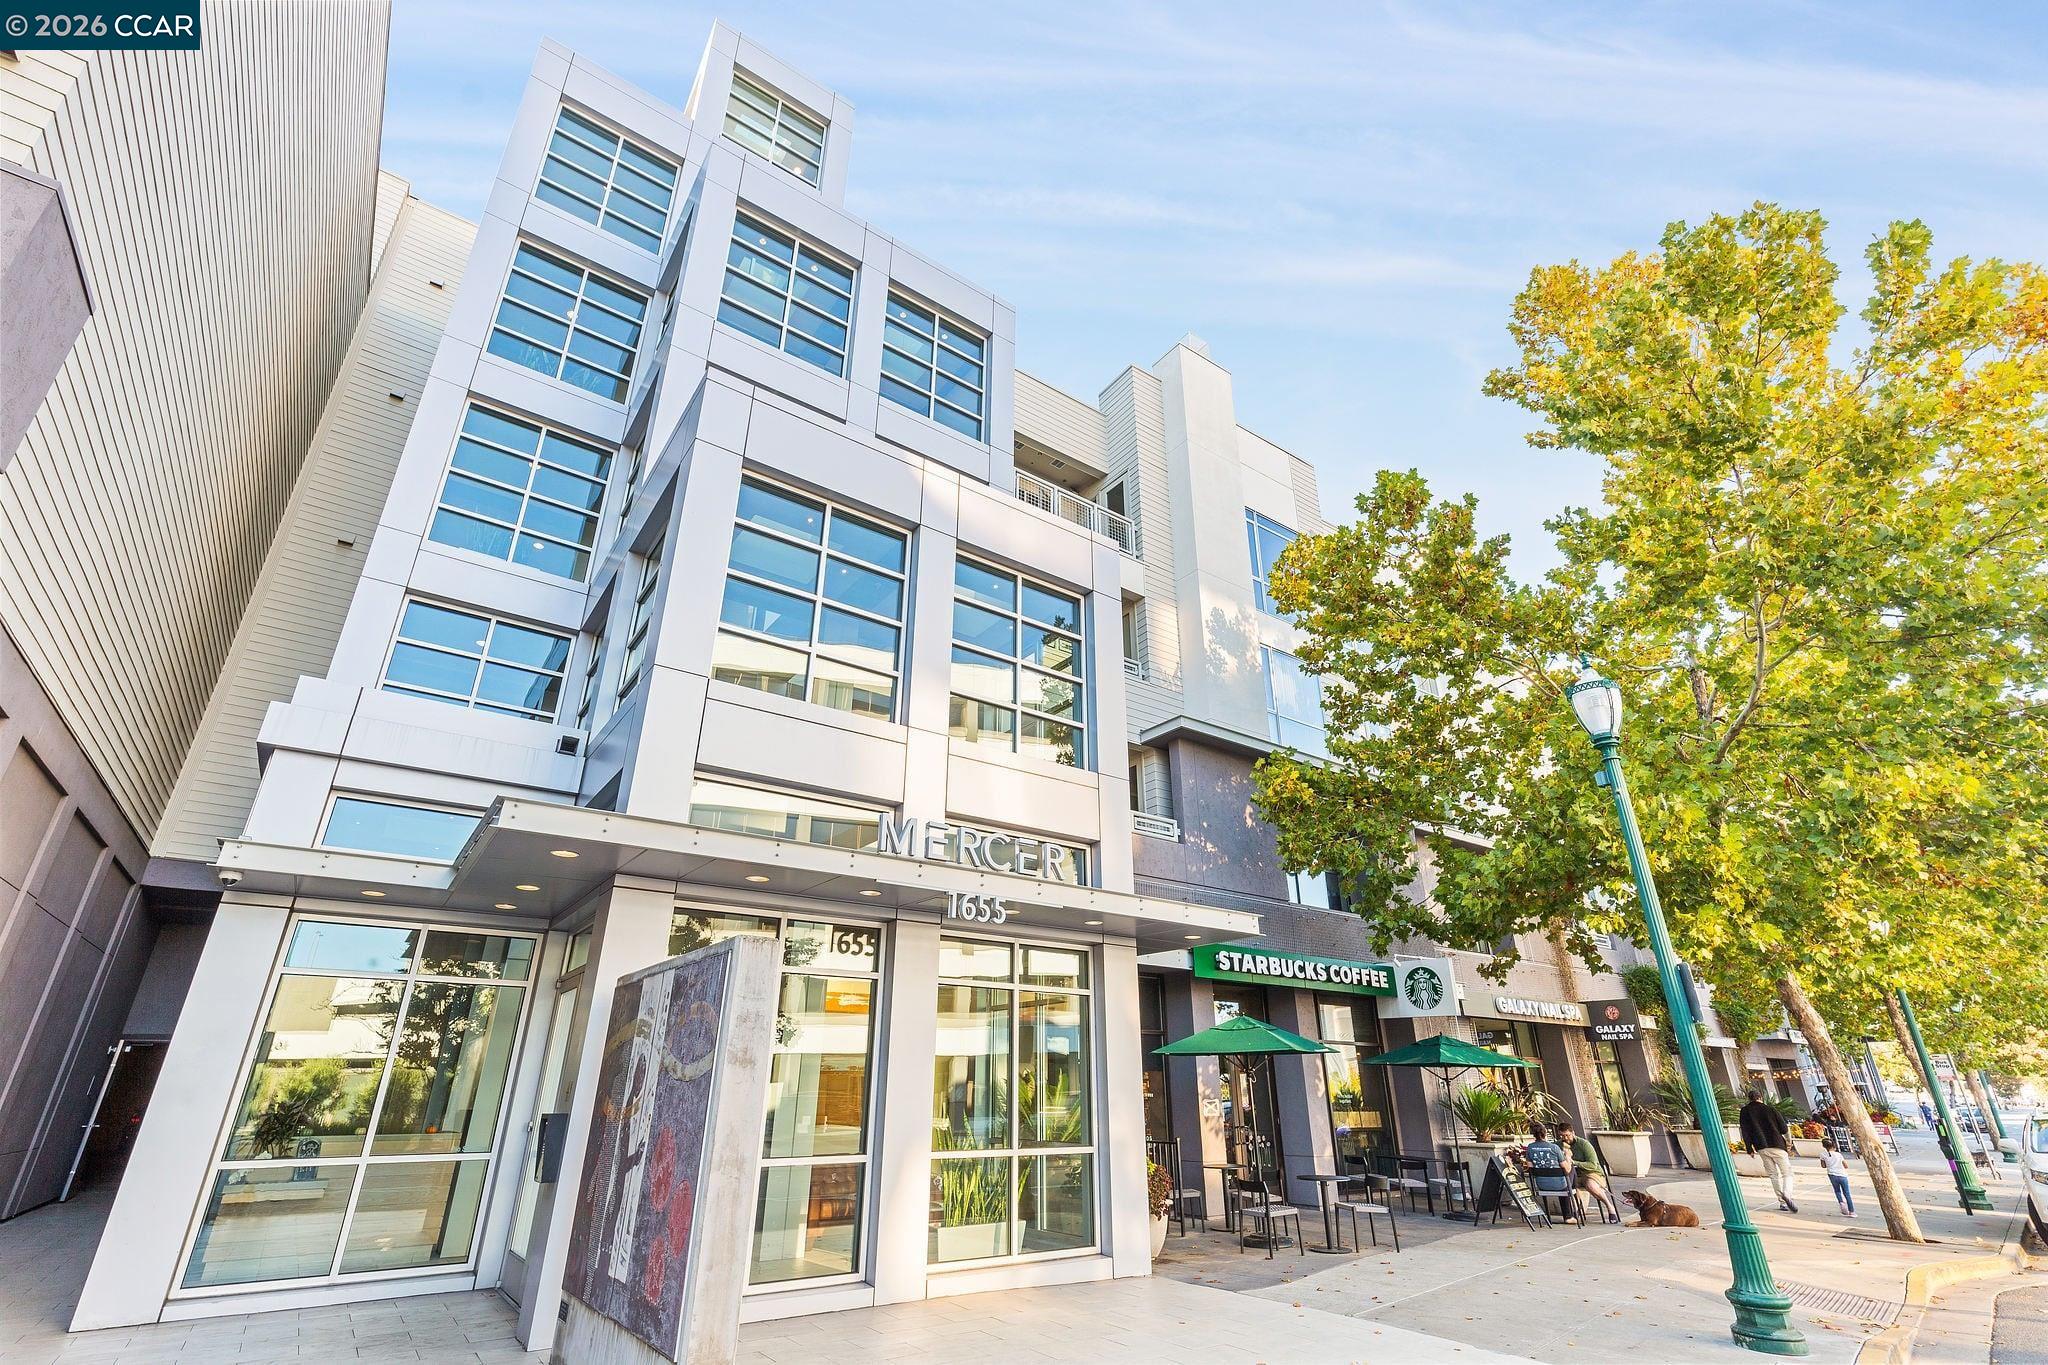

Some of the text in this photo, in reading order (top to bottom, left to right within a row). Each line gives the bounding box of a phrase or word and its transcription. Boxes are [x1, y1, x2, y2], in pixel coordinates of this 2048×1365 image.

[878, 812, 1066, 880] MERCER
[946, 890, 1007, 924] 1655
[1218, 950, 1389, 988] STARBUCKS COFFEE
[1495, 996, 1583, 1021] GALAXY NAIL SPA
[1595, 1024, 1636, 1034] GALAXY
